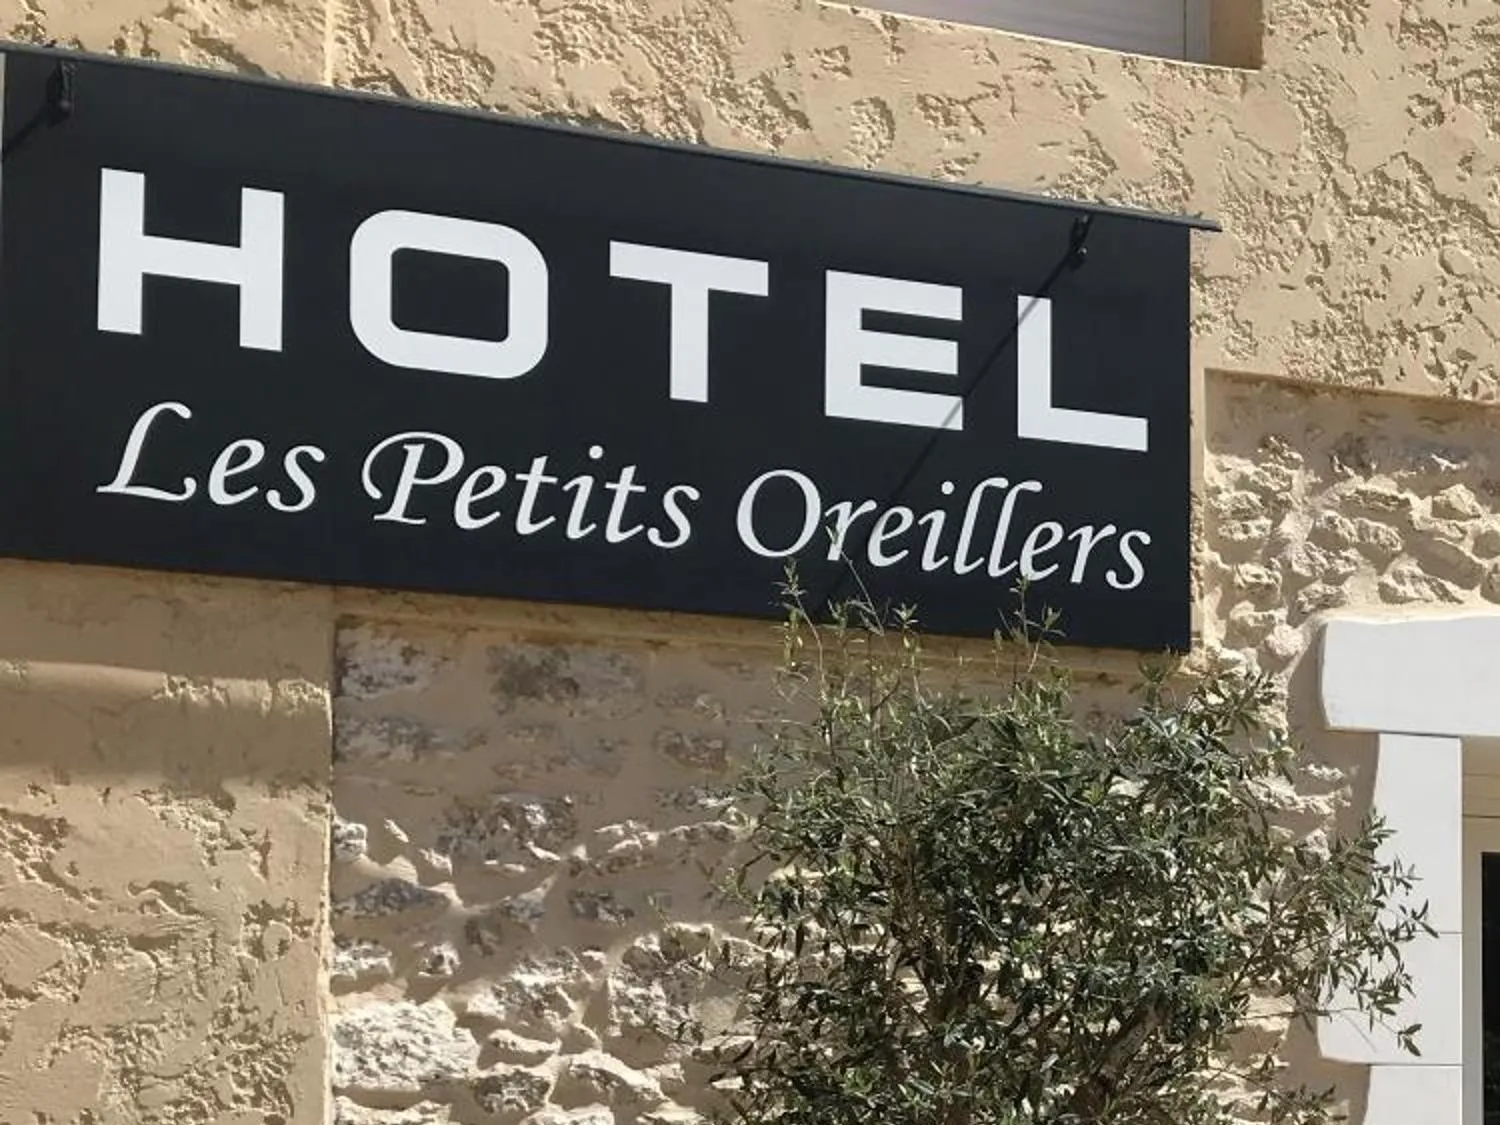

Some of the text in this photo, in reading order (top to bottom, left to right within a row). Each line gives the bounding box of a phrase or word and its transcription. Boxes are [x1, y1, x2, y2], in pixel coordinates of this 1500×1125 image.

[97, 167, 1149, 452] HOTEL
[96, 401, 1152, 591] Les Petits Oreillers
